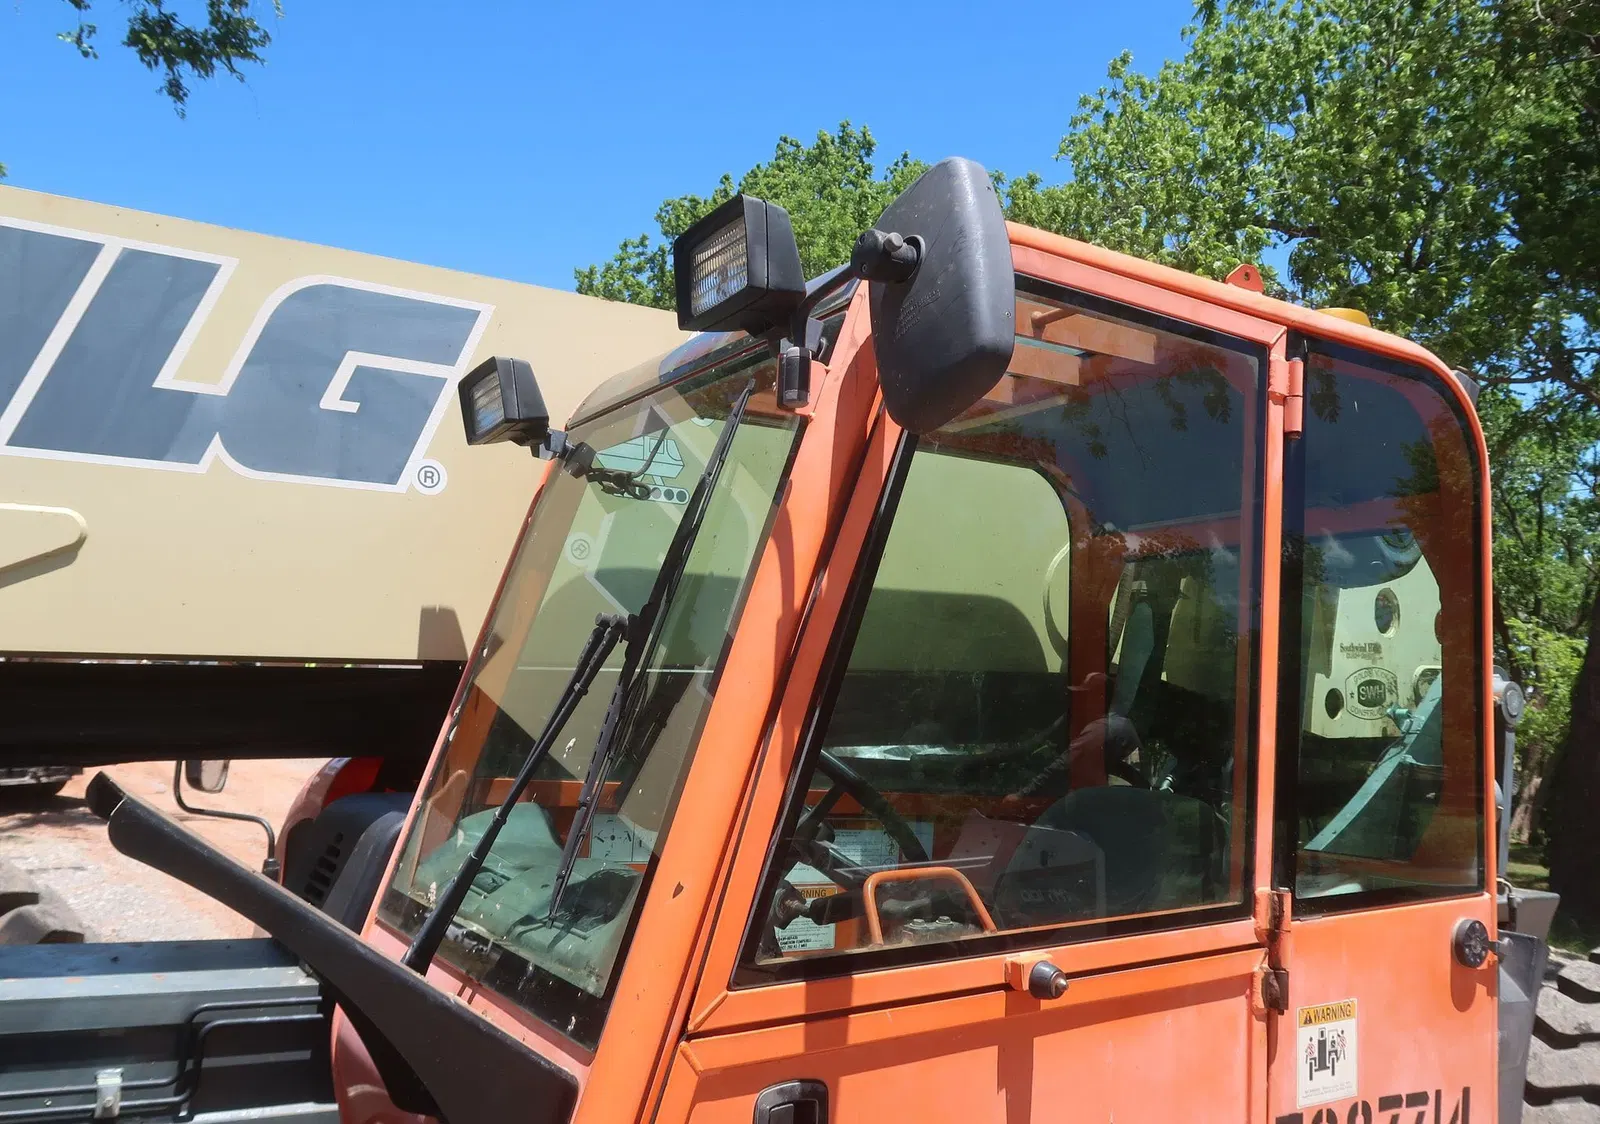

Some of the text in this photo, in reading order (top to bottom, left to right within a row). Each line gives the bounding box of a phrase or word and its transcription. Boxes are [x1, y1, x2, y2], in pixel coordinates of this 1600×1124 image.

[1359, 684, 1385, 701] SWH
[800, 888, 827, 898] RNING
[1313, 1003, 1351, 1023] WARNING
